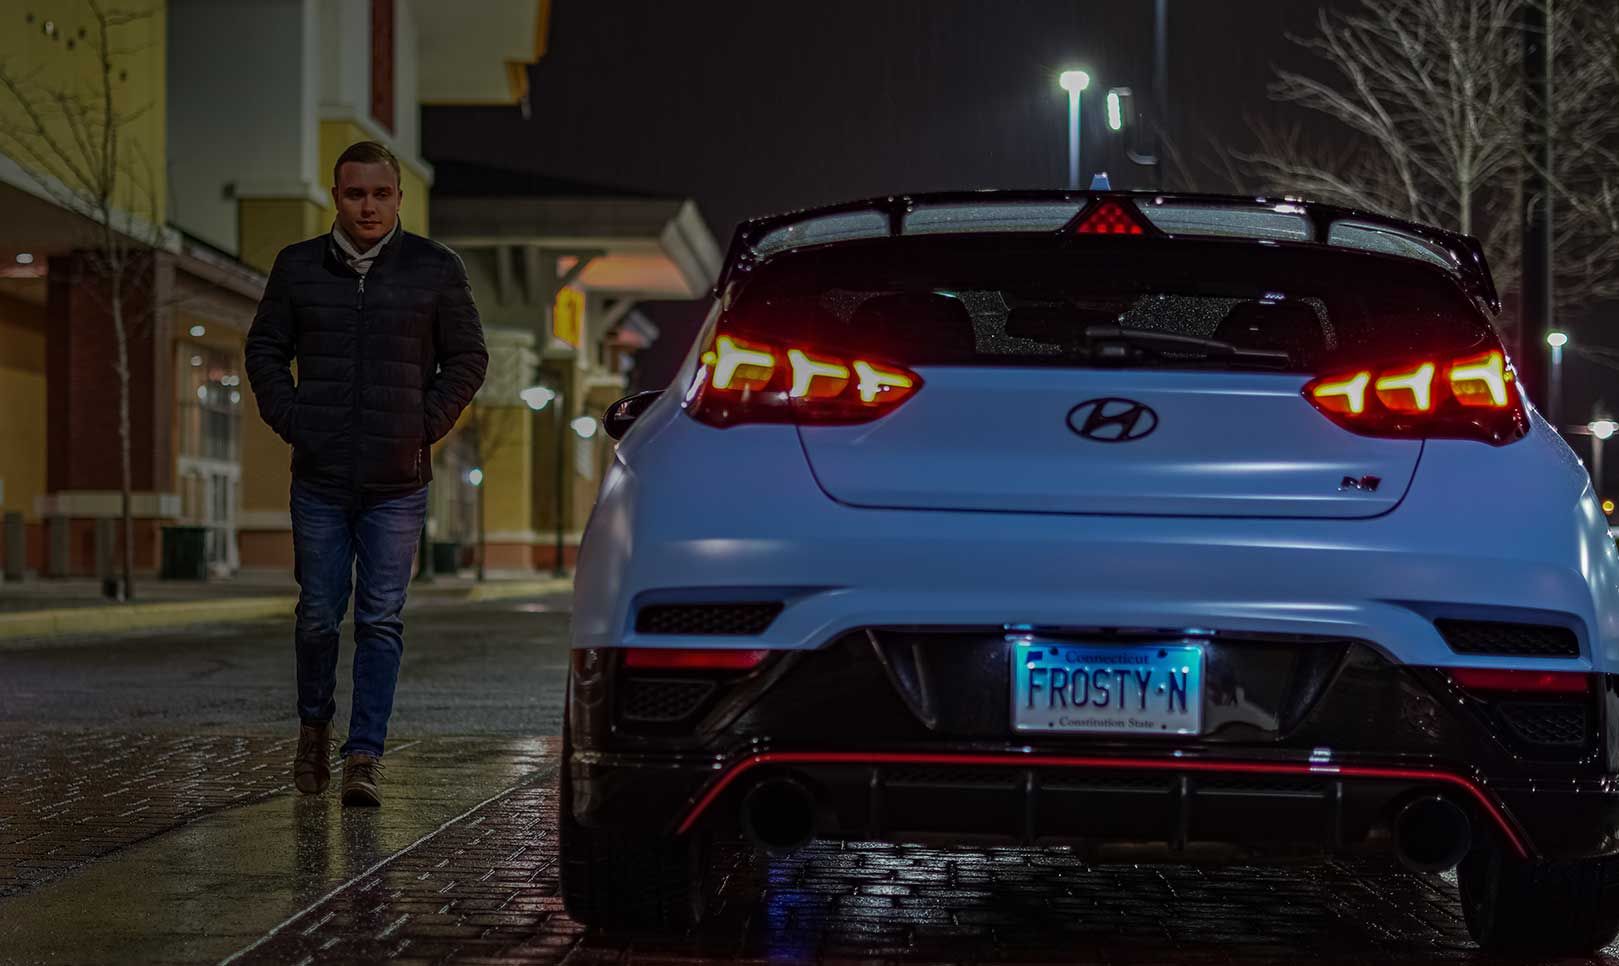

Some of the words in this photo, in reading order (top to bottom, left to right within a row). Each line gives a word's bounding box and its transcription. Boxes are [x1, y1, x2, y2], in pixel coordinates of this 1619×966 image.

[1065, 653, 1150, 664] Connecticut
[1060, 716, 1125, 729] Constitution
[1128, 718, 1155, 729] State
